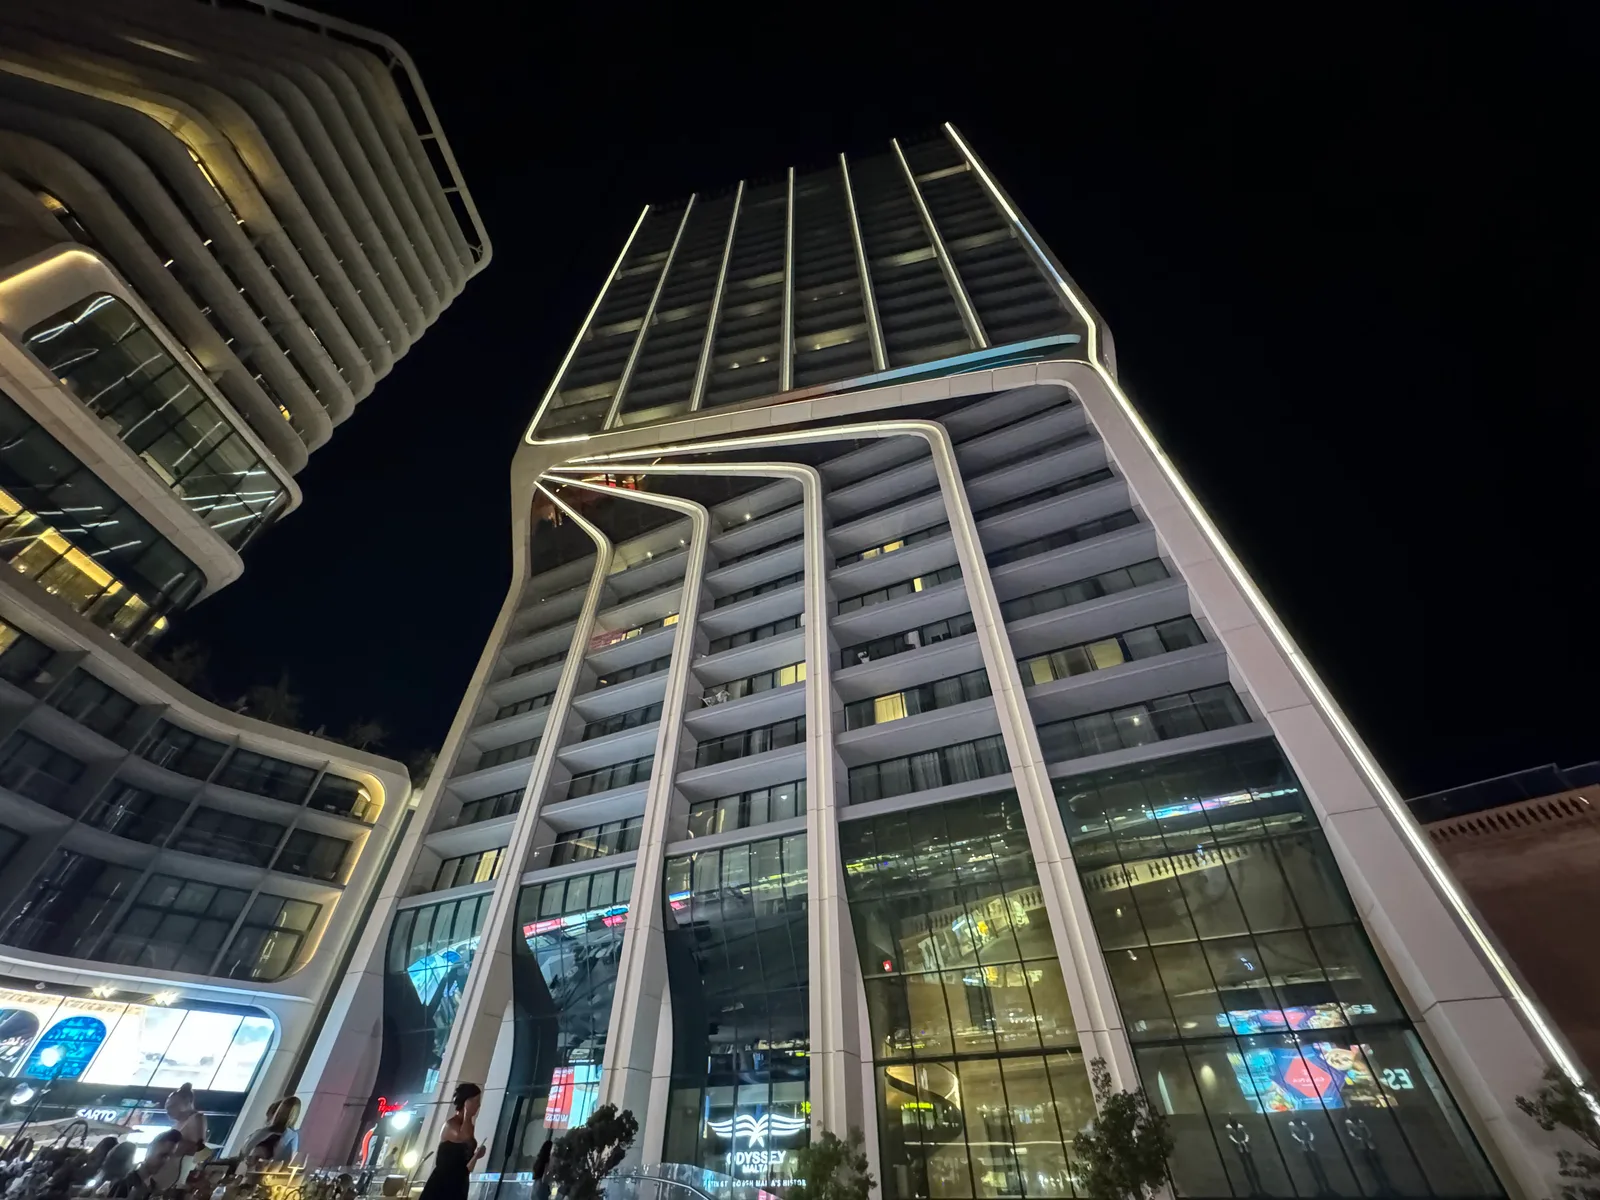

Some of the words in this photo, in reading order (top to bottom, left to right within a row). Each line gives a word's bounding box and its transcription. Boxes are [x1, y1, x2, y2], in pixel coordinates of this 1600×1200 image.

[77, 1109, 117, 1122] SARTO
[726, 1150, 786, 1165] ODYSSEY
[742, 1164, 768, 1173] MALTA
[782, 1178, 807, 1187] HISTOR
